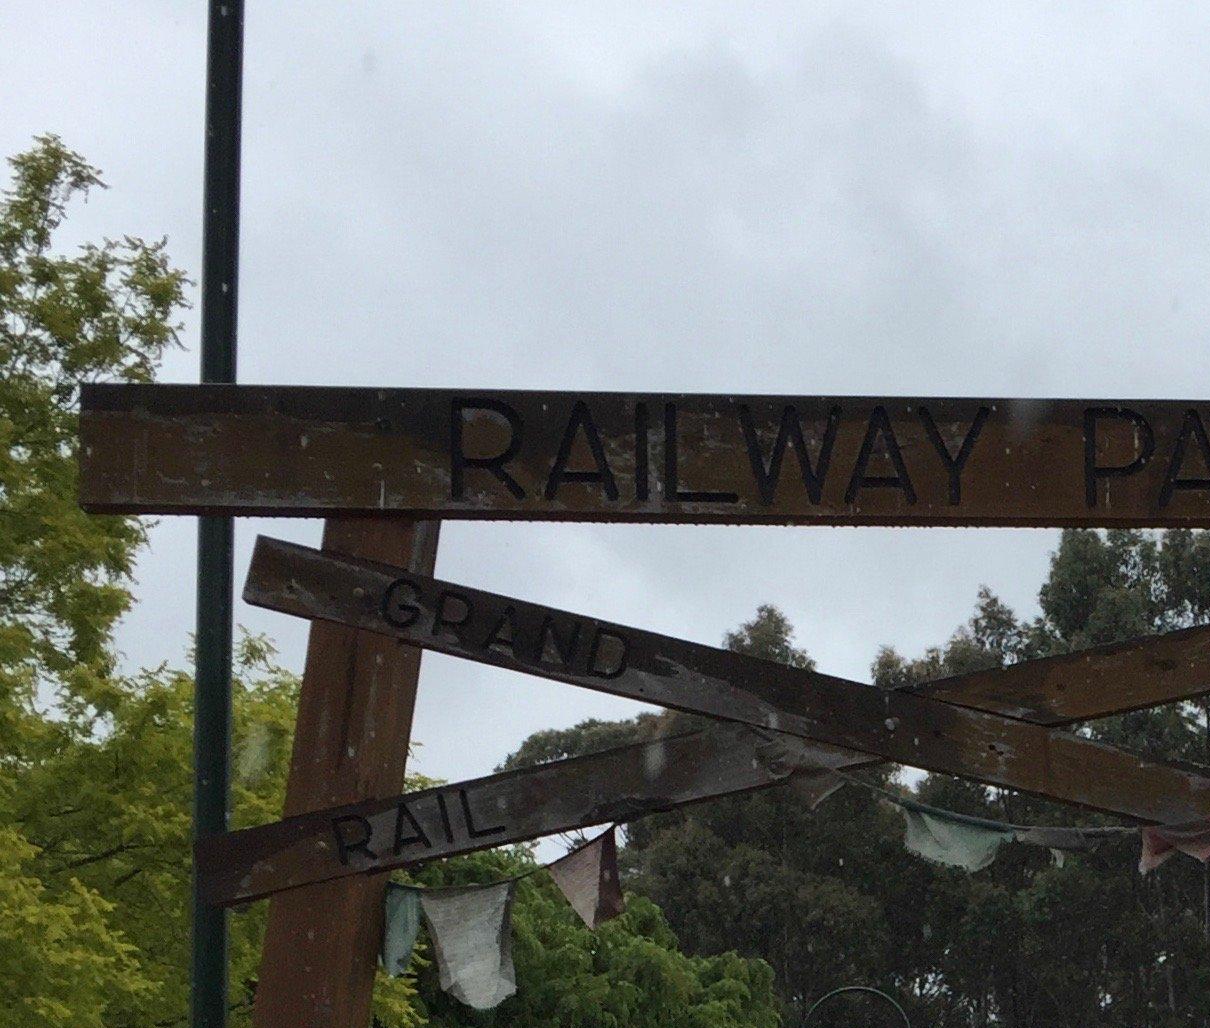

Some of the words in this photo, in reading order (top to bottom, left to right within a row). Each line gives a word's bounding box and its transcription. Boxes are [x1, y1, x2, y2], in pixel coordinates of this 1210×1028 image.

[450, 401, 990, 506] RAILWAY
[382, 579, 627, 678] GRAND
[333, 788, 507, 866] RAIL
